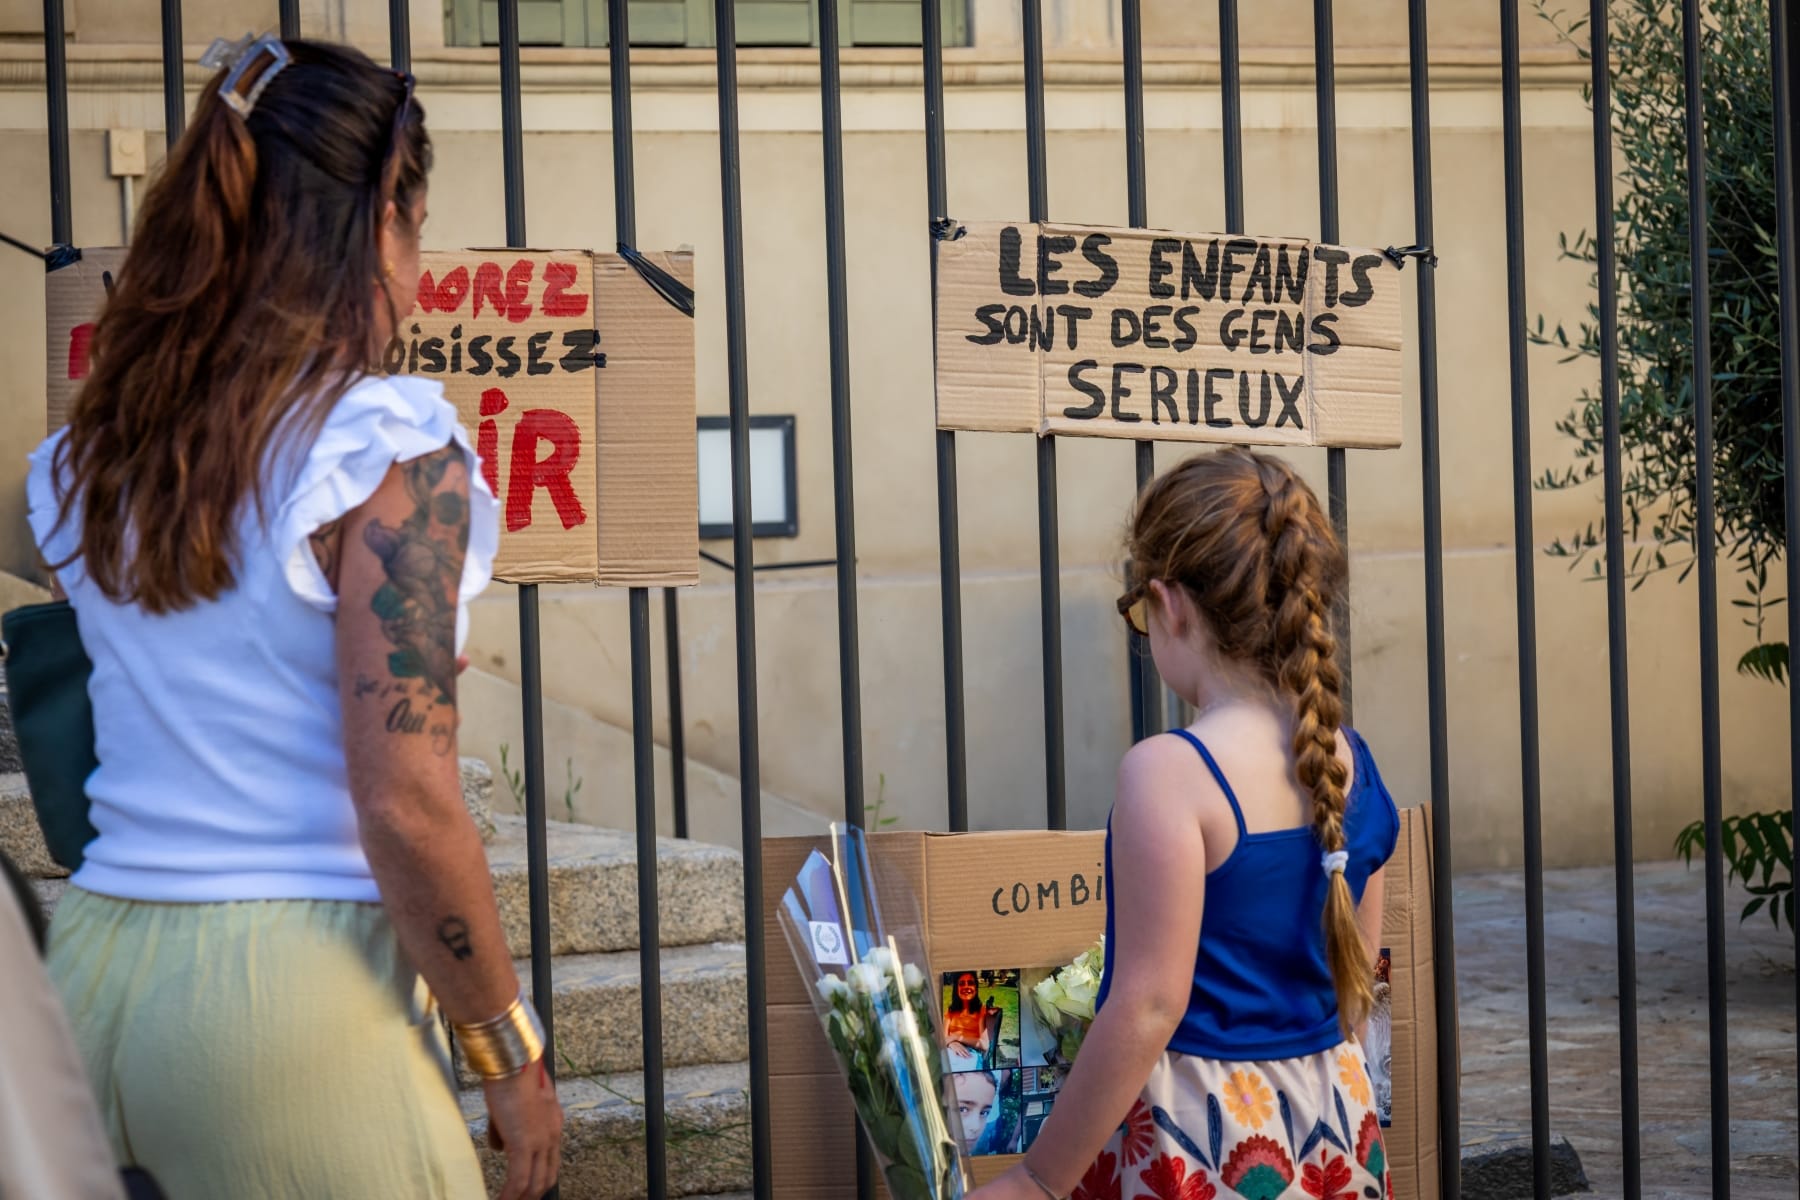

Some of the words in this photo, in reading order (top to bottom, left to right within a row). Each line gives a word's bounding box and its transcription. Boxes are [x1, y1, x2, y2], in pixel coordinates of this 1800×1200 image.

[1000, 226, 1119, 298] LES
[1149, 238, 1383, 307] ENFANTS
[383, 323, 607, 378] OiSiSSEZ
[966, 304, 1093, 352] SONT
[1111, 305, 1200, 352] DES
[1220, 308, 1341, 355] GENS
[1063, 359, 1305, 430] SERIEUX
[992, 862, 1103, 916] COMBi
